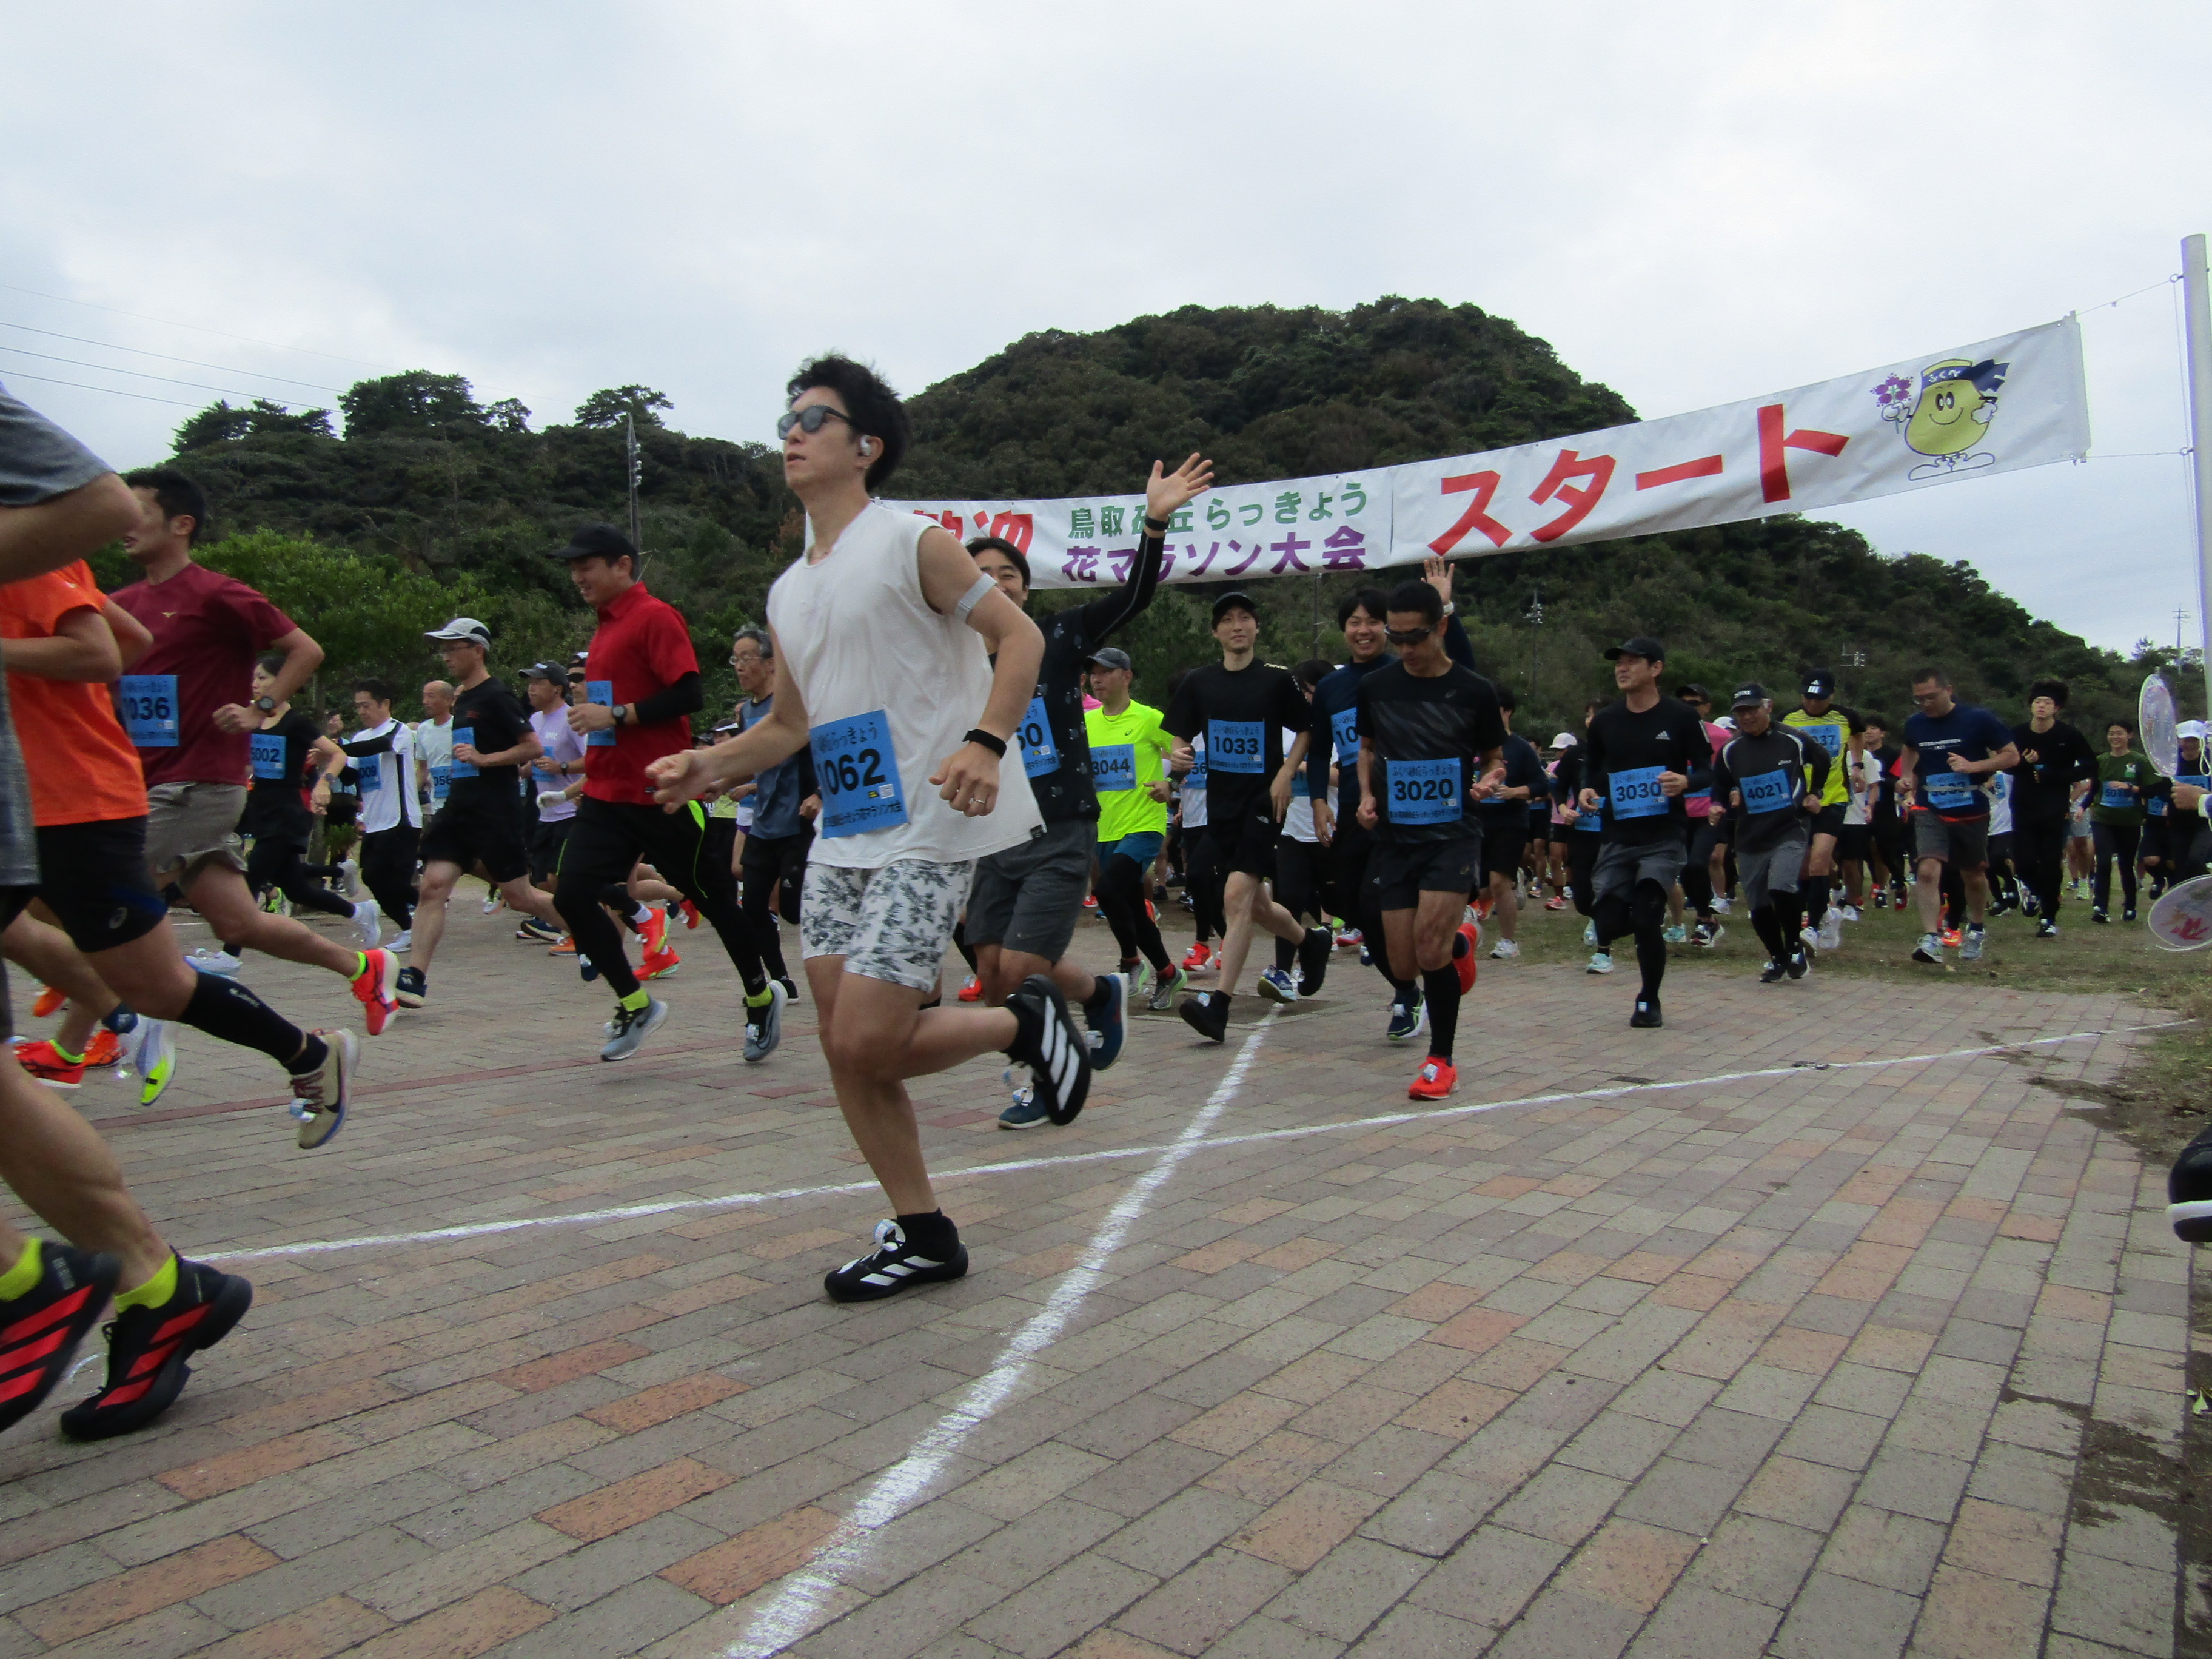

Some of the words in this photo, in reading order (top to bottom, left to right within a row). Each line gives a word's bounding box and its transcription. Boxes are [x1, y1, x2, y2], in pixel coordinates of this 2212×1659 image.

[1427, 403, 1850, 556] スタート
[1061, 525, 1367, 583] 花マラソン大会
[1214, 736, 1259, 755] 1033
[1092, 758, 1130, 776] 3044
[1395, 778, 1453, 802] 3020
[1616, 781, 1662, 802] 3030
[1748, 782, 1783, 800] 4021
